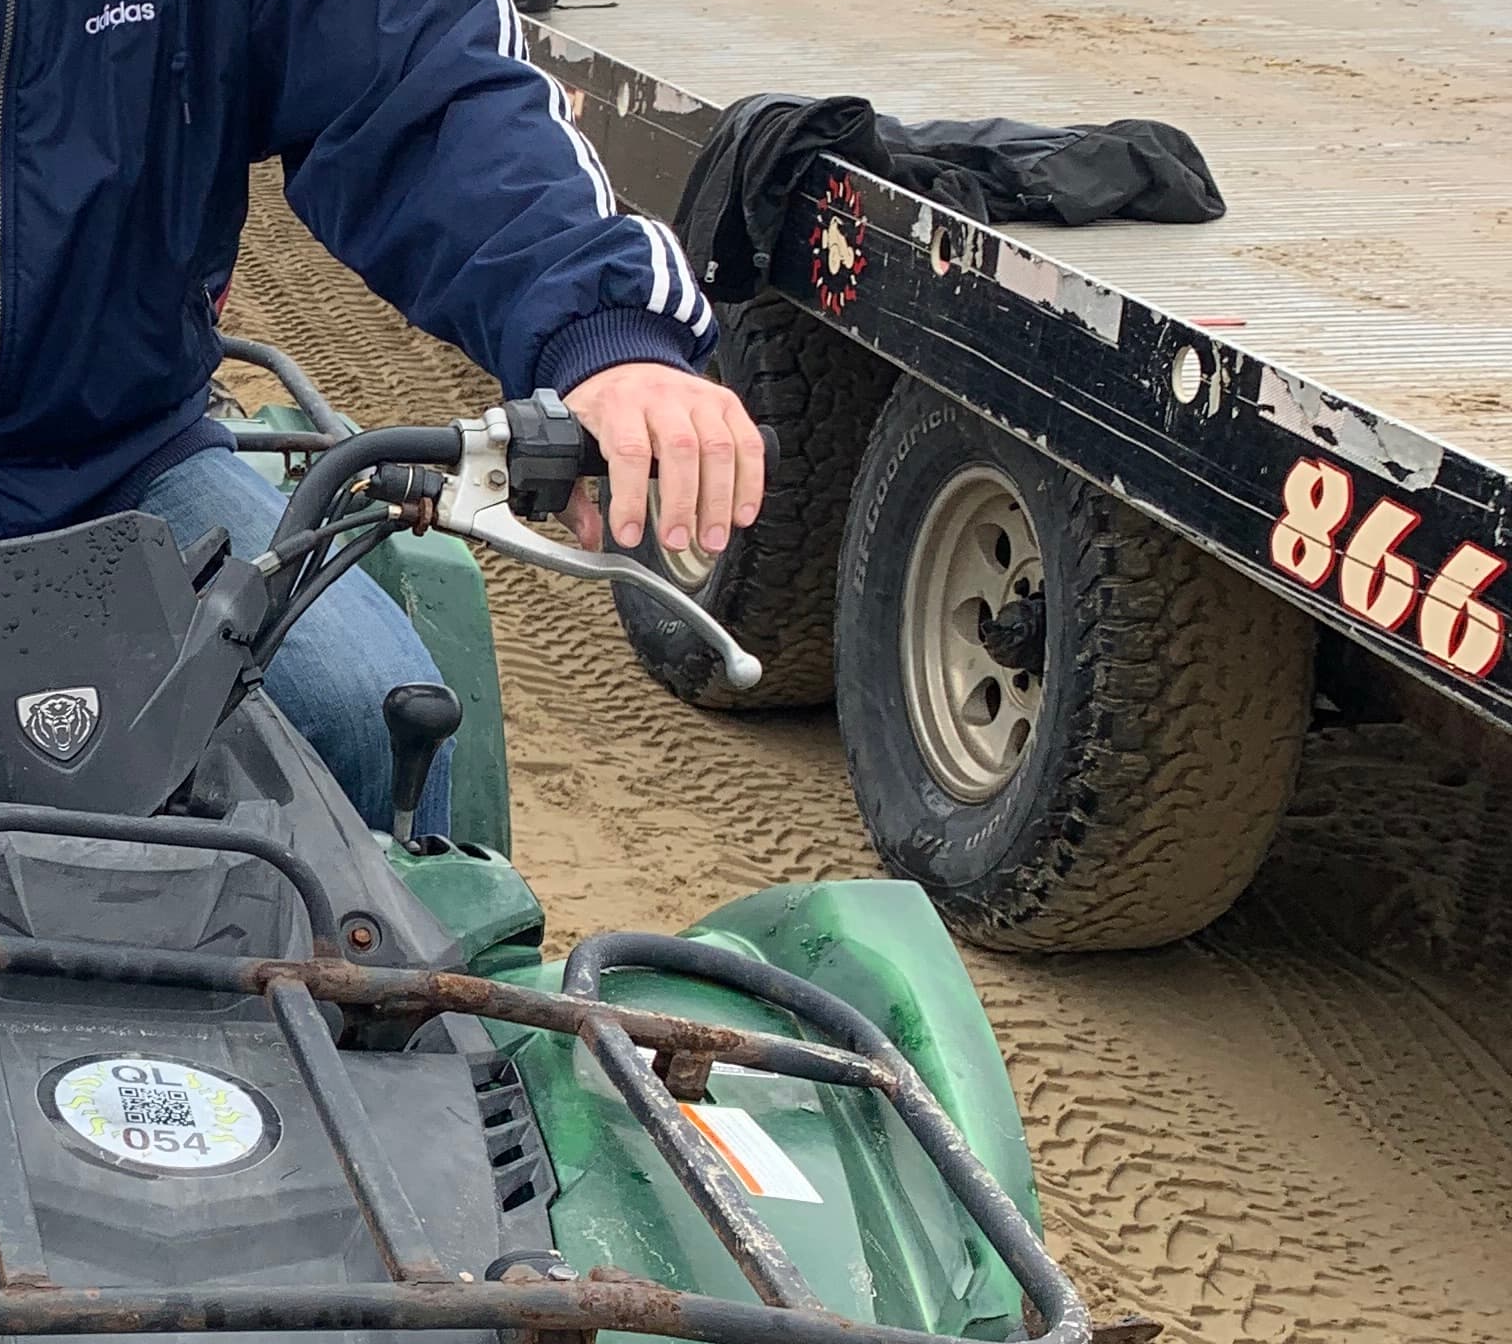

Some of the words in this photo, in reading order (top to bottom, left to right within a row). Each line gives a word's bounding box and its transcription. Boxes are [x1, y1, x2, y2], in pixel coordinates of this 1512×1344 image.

[84, 0, 156, 35] adidas
[853, 403, 957, 596] BFGoodrich
[1269, 455, 1508, 682] 866
[111, 1064, 183, 1088] QL
[122, 1126, 212, 1156] 054
